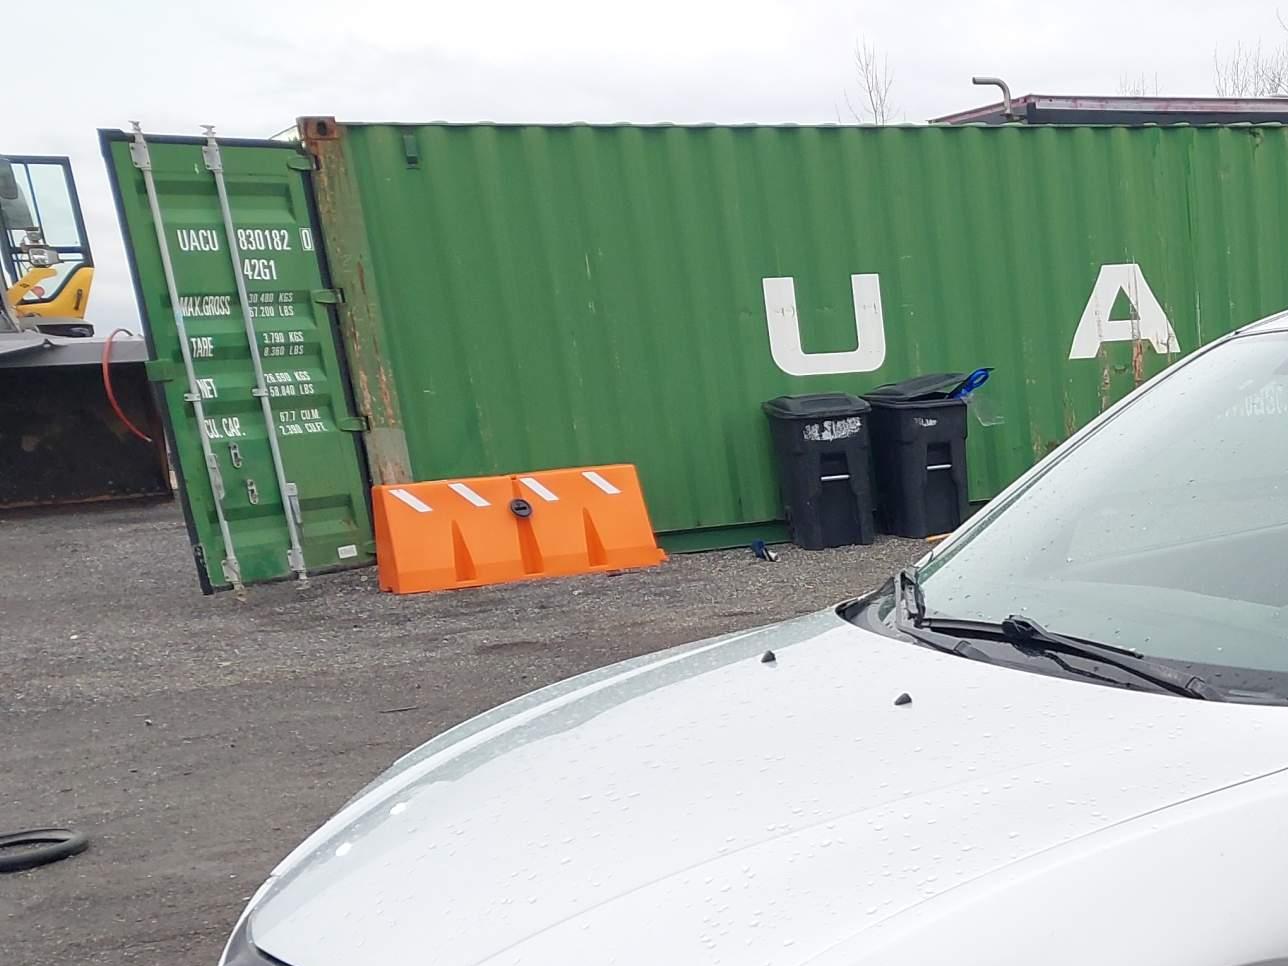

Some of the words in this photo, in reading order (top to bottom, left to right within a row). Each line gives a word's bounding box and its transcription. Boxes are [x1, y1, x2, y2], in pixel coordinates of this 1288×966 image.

[177, 229, 219, 251] UACU
[237, 229, 291, 250] 830182
[302, 229, 313, 249] 0
[243, 259, 277, 280] 42G1
[278, 292, 294, 302] KGS
[180, 296, 231, 316] MAX.GROSS
[279, 306, 294, 316] LBS
[288, 331, 304, 342] KGS
[190, 337, 214, 358] TARE
[289, 345, 304, 355] LBS
[294, 371, 311, 381] KGS
[195, 378, 218, 398] NET
[299, 384, 315, 395] LBS
[204, 418, 223, 438] CU.
[221, 417, 246, 437] CAP.
